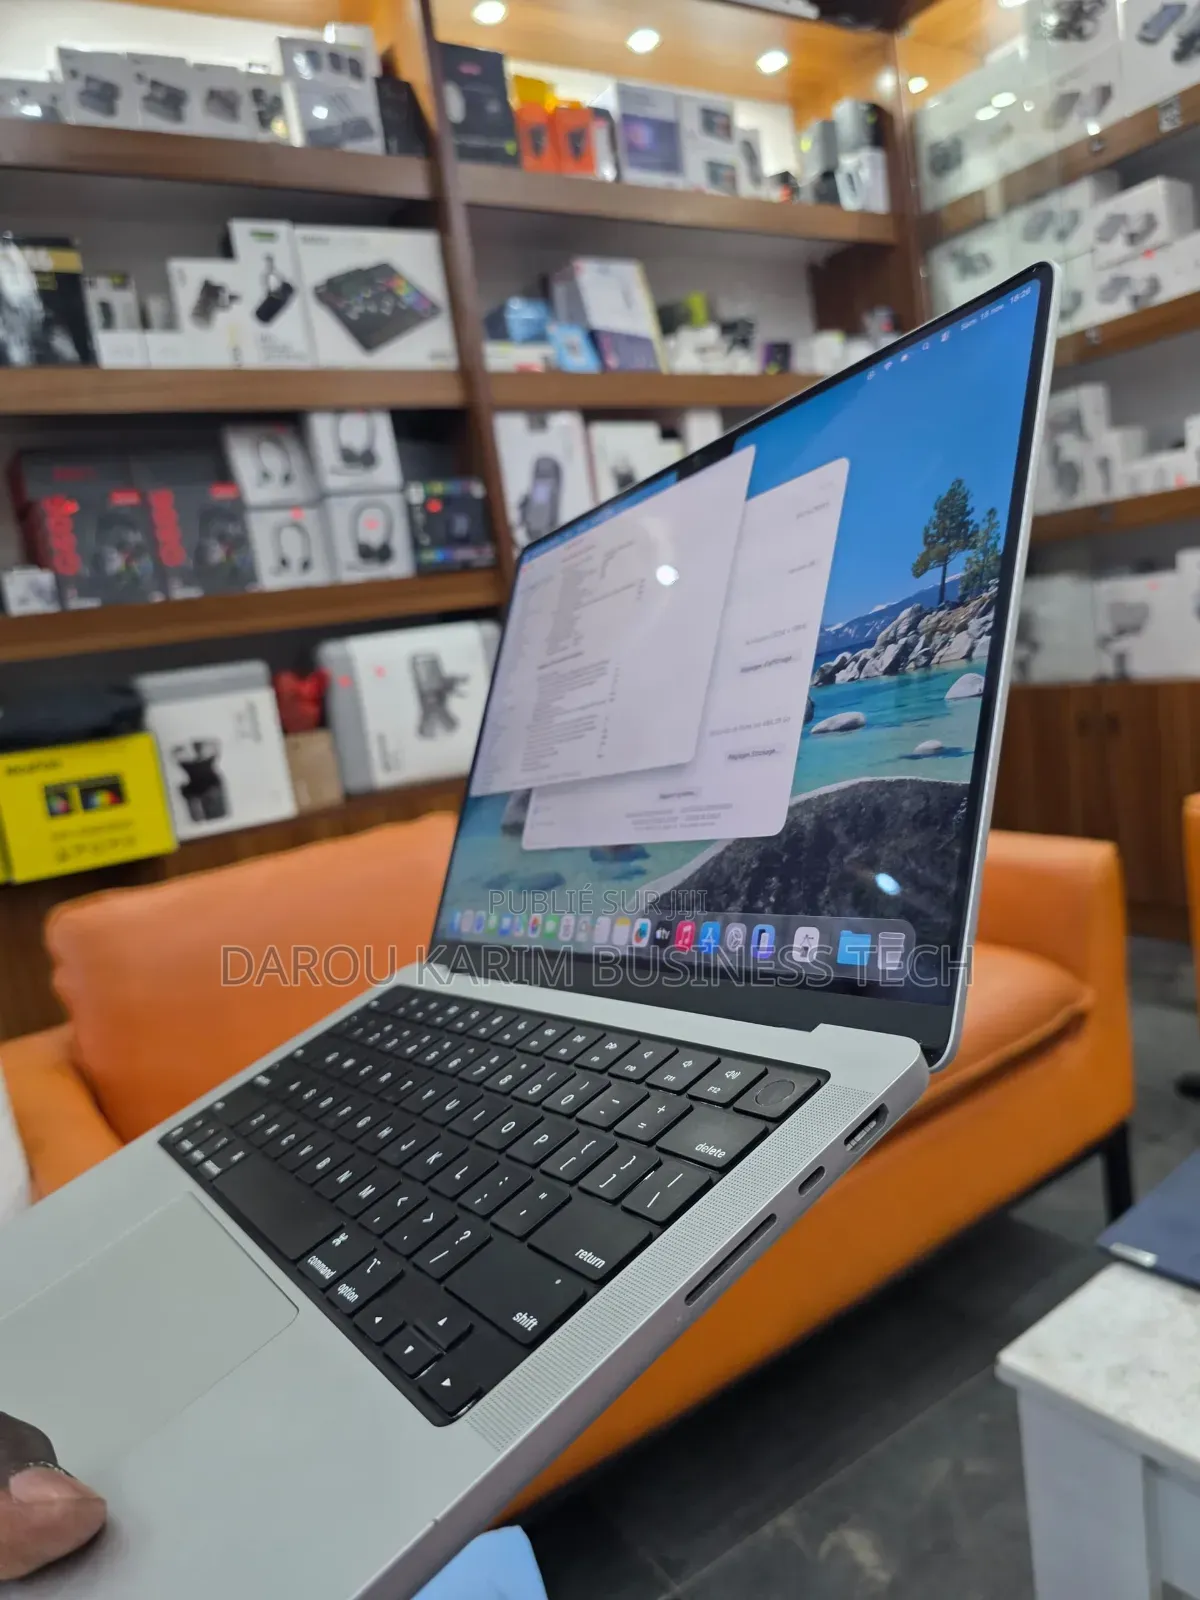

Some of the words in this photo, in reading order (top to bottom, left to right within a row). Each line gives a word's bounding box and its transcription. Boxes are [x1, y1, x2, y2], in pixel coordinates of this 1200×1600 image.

[498, 1074, 513, 1086] 8
[421, 1088, 436, 1101] Y
[527, 1083, 542, 1096] 9
[706, 1085, 722, 1094] F12
[444, 1098, 461, 1111] U
[560, 1093, 575, 1106] 0
[500, 1121, 516, 1134] O
[533, 1133, 549, 1146] P
[694, 1142, 726, 1159] delete
[425, 1151, 443, 1165] K
[336, 1169, 353, 1184] N
[358, 1184, 376, 1200] M
[454, 1230, 472, 1245] ?
[574, 1248, 606, 1269] return
[307, 1255, 337, 1280] command
[337, 1283, 359, 1303] option
[511, 1311, 539, 1332] shift
